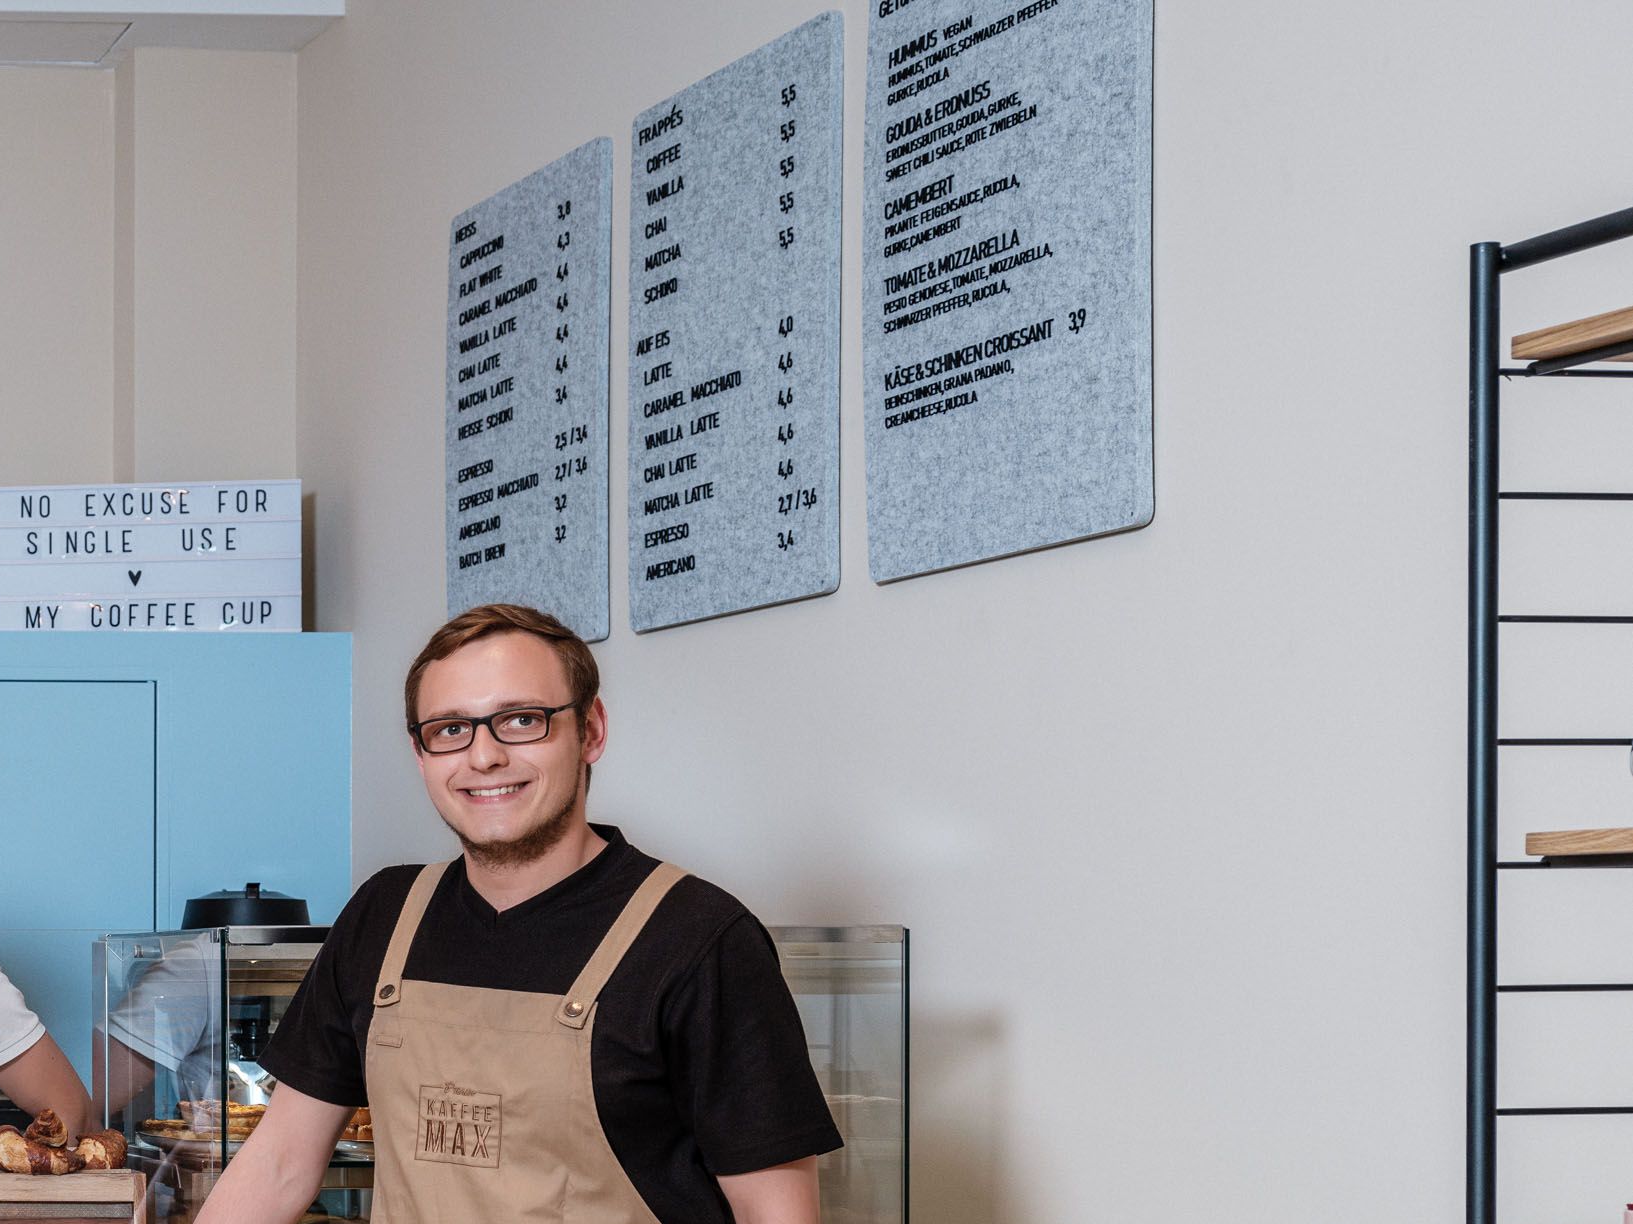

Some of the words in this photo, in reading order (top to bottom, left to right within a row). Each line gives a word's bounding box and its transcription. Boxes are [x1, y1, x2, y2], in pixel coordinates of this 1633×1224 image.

[888, 29, 937, 69] HUMMUS
[943, 16, 972, 41] VEGAN
[639, 104, 684, 146] FRAPPÉS
[646, 143, 681, 174] COFFEE
[782, 84, 796, 107] 5,5
[886, 112, 922, 144] GOUDA
[924, 107, 933, 126] &
[934, 80, 990, 121] ERDNUSS
[646, 176, 684, 206] VANILLA
[780, 120, 795, 142] 5,5
[886, 160, 912, 182] SWEET
[913, 150, 934, 170] CHILI
[989, 105, 1037, 136] ZWIEBELN
[645, 216, 666, 239] CHAI
[780, 156, 794, 178] 5,5
[884, 175, 954, 220] CAMEMBERT
[455, 221, 476, 244] HEISS
[460, 235, 504, 268] CAPPUCCINO
[558, 201, 571, 220] 3,8
[645, 244, 682, 272] MATCHA
[780, 192, 794, 214] 5,5
[884, 214, 918, 239] PIKANTE
[460, 278, 477, 298] FLAT
[480, 264, 502, 287] WHITE
[558, 232, 570, 250] 4,3
[644, 278, 678, 304] SCHOKO
[779, 227, 793, 250] 5,5
[459, 300, 492, 326] CARAMEL
[495, 278, 538, 309] MACCHIATO
[884, 294, 907, 316] PESTO
[884, 304, 932, 334] SCHWARZER
[460, 330, 490, 354] VANILLA
[494, 317, 516, 340] LATTE
[636, 336, 653, 356] AUF
[656, 330, 670, 348] EIS
[644, 362, 672, 386] LATTE
[778, 316, 793, 338] 4,0
[984, 318, 1054, 358] CROISSANT
[1069, 308, 1086, 334] 3,9
[458, 364, 476, 382] CHAI
[478, 353, 500, 374] LATTE
[644, 390, 686, 418] CARAMEL
[691, 370, 742, 402] MACCHIATO
[778, 352, 792, 374] 4,6
[458, 389, 487, 412] MATCHA
[490, 377, 514, 398] LATTE
[458, 419, 482, 440] HEISSE
[486, 407, 513, 430] SCHOKI
[645, 424, 683, 450] VANILLA
[690, 412, 720, 436] LATTE
[778, 388, 793, 409] 4,6
[458, 460, 493, 483] ESPRESSO
[644, 462, 666, 483] CHAI
[669, 453, 697, 476] LATTE
[778, 424, 794, 444] 4,6
[20, 495, 51, 518] NO
[86, 491, 190, 516] EXCUSE
[218, 489, 268, 514] FOR
[458, 488, 493, 512] ESPRESSO
[498, 473, 538, 499] MACCHIATO
[644, 492, 680, 516] MATCHA
[685, 482, 714, 504] LATTE
[778, 459, 793, 480] 4,6
[26, 530, 133, 554] SINGLE
[182, 527, 236, 552] USE
[460, 516, 500, 540] AMERICANO
[644, 523, 690, 548] ESPRESSO
[460, 551, 482, 570] BATCH
[485, 544, 506, 562] BREW
[646, 555, 696, 581] AMERICANO
[778, 530, 794, 551] 3,4
[25, 606, 59, 629] MY
[90, 602, 195, 628] COFFEE
[222, 601, 272, 626] CUP
[427, 1099, 492, 1122] KAFFEE
[425, 1120, 492, 1158] MAX
